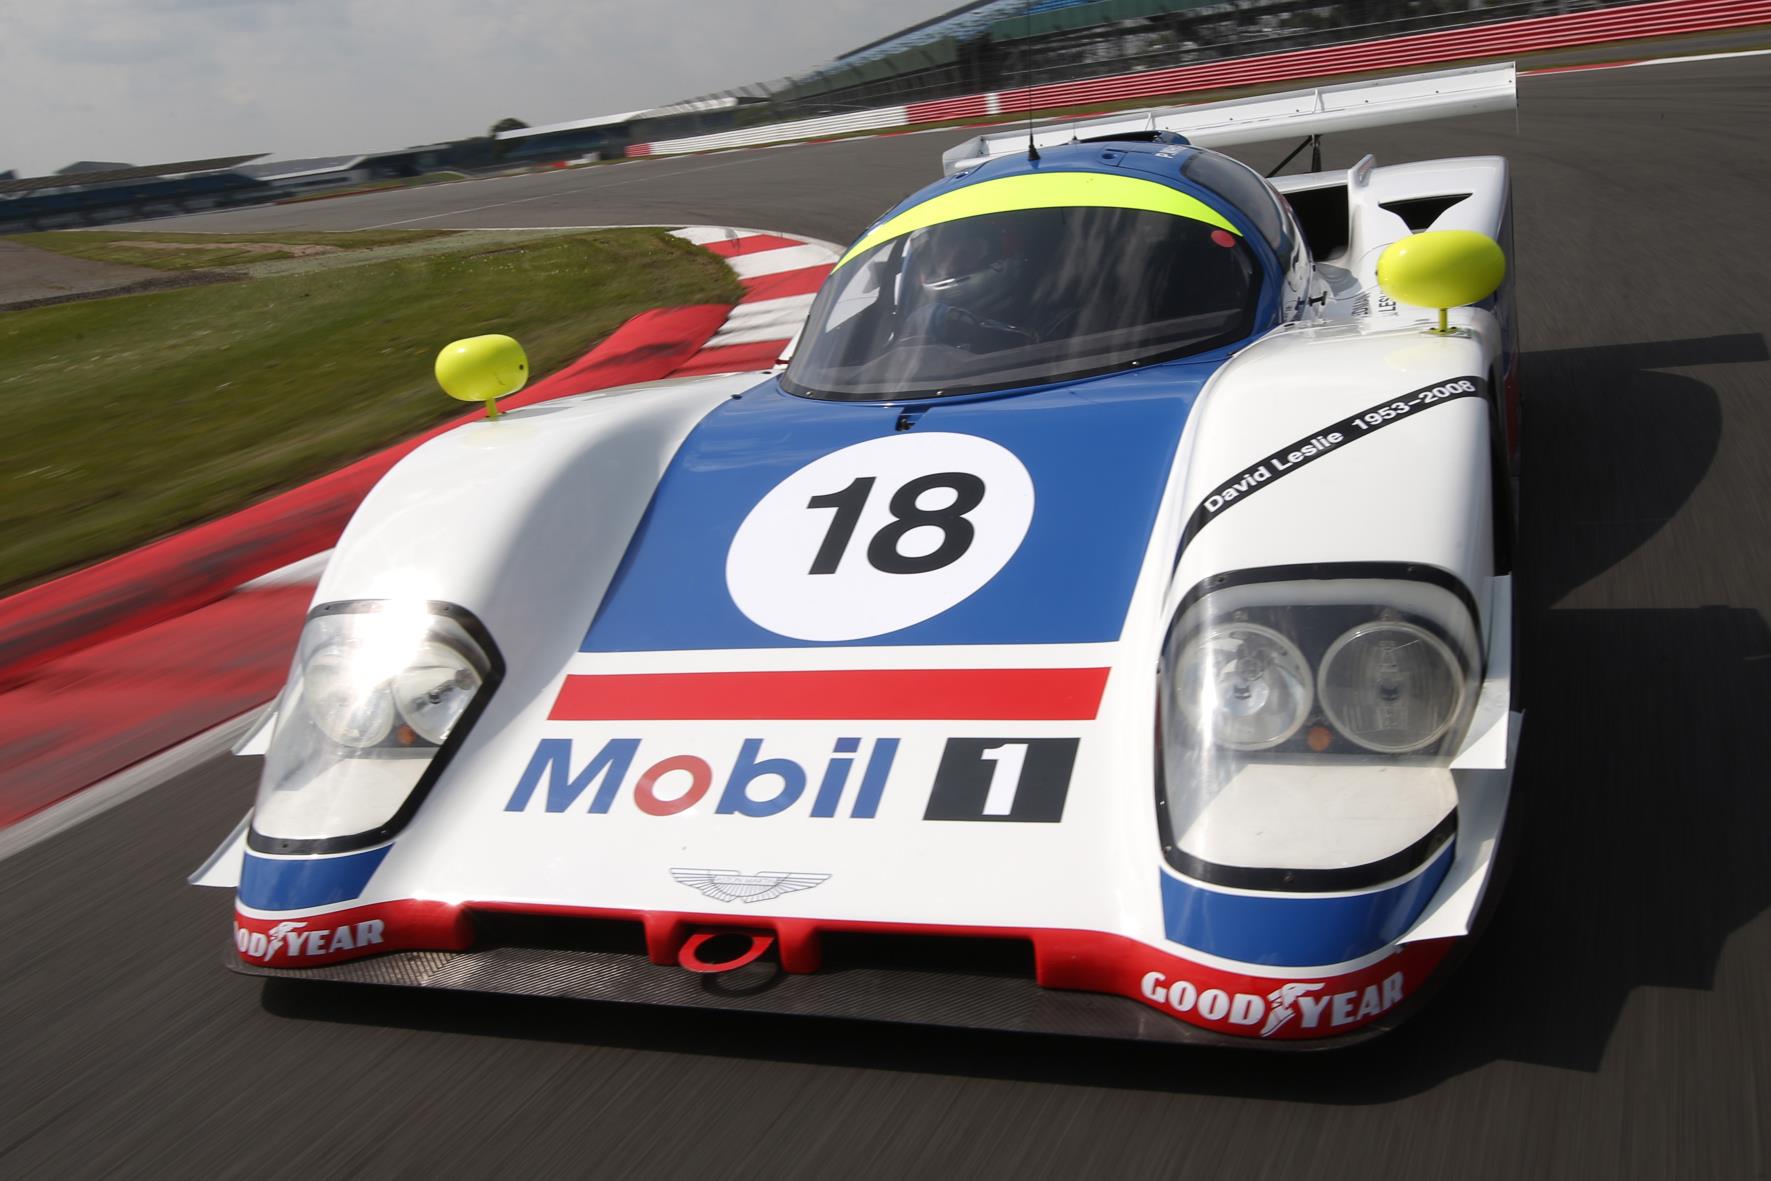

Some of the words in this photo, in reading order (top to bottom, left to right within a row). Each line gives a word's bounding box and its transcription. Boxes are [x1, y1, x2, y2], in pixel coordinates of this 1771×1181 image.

[1203, 466, 1272, 513] David
[1271, 430, 1344, 472] Leslie
[806, 471, 986, 575] 18
[503, 737, 901, 818] Mobil
[981, 743, 1030, 816] 1
